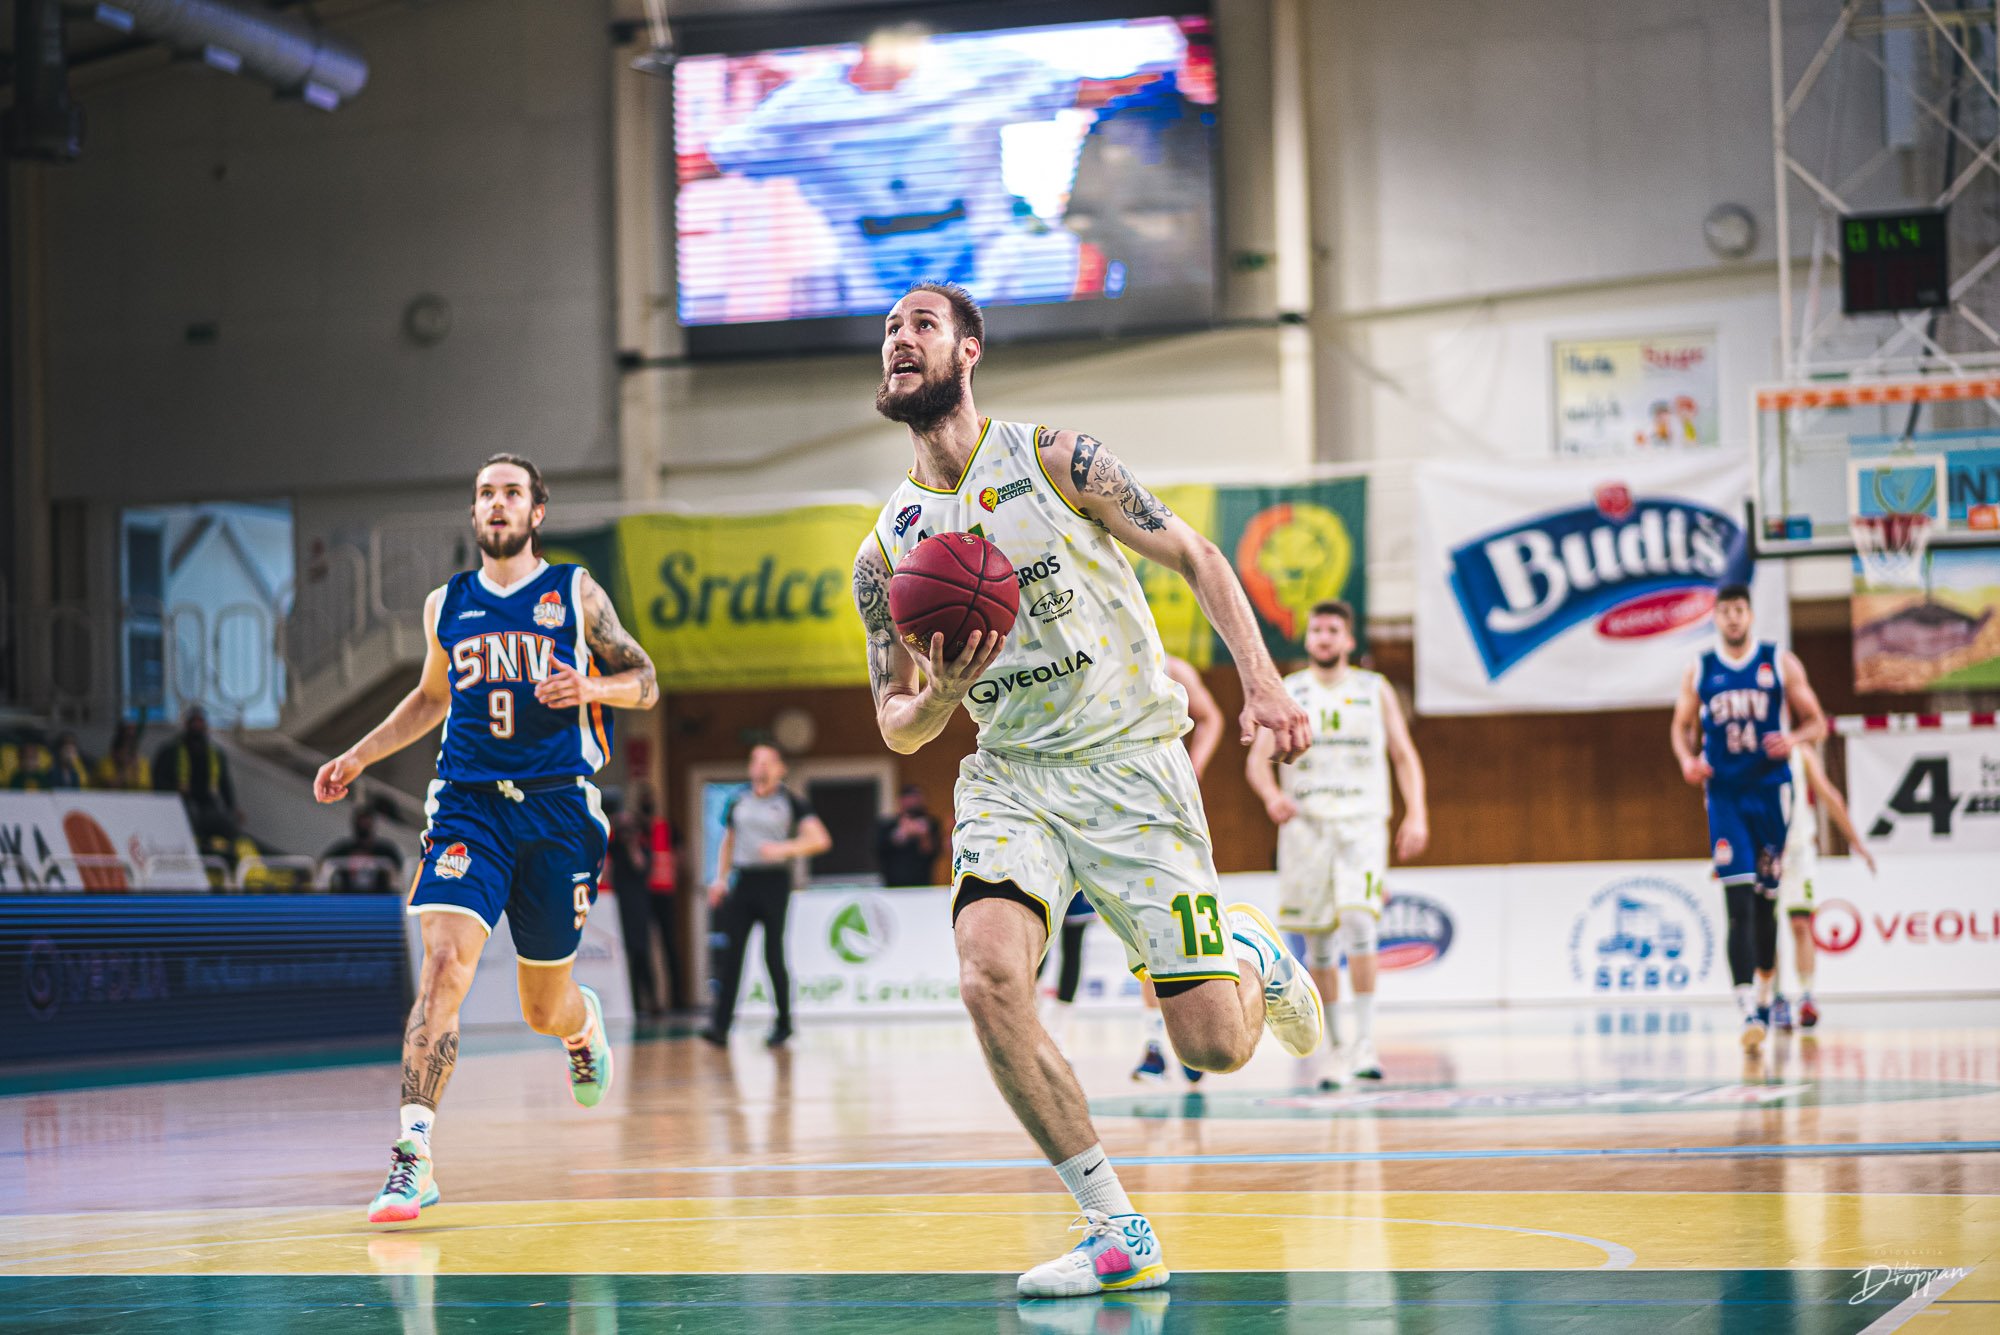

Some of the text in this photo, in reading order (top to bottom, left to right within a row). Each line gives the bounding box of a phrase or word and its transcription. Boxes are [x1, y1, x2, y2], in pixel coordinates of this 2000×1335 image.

[997, 477, 1031, 495] PATRIOTI
[1000, 487, 1031, 502] Levice
[650, 551, 843, 630] Srdce
[1040, 596, 1064, 610] TAM
[453, 631, 555, 691] SNV
[999, 650, 1093, 692] VEOLIA
[488, 689, 515, 739] 9
[573, 883, 590, 930] 9
[1170, 892, 1225, 957] 13
[1596, 966, 1690, 989] SEBO
